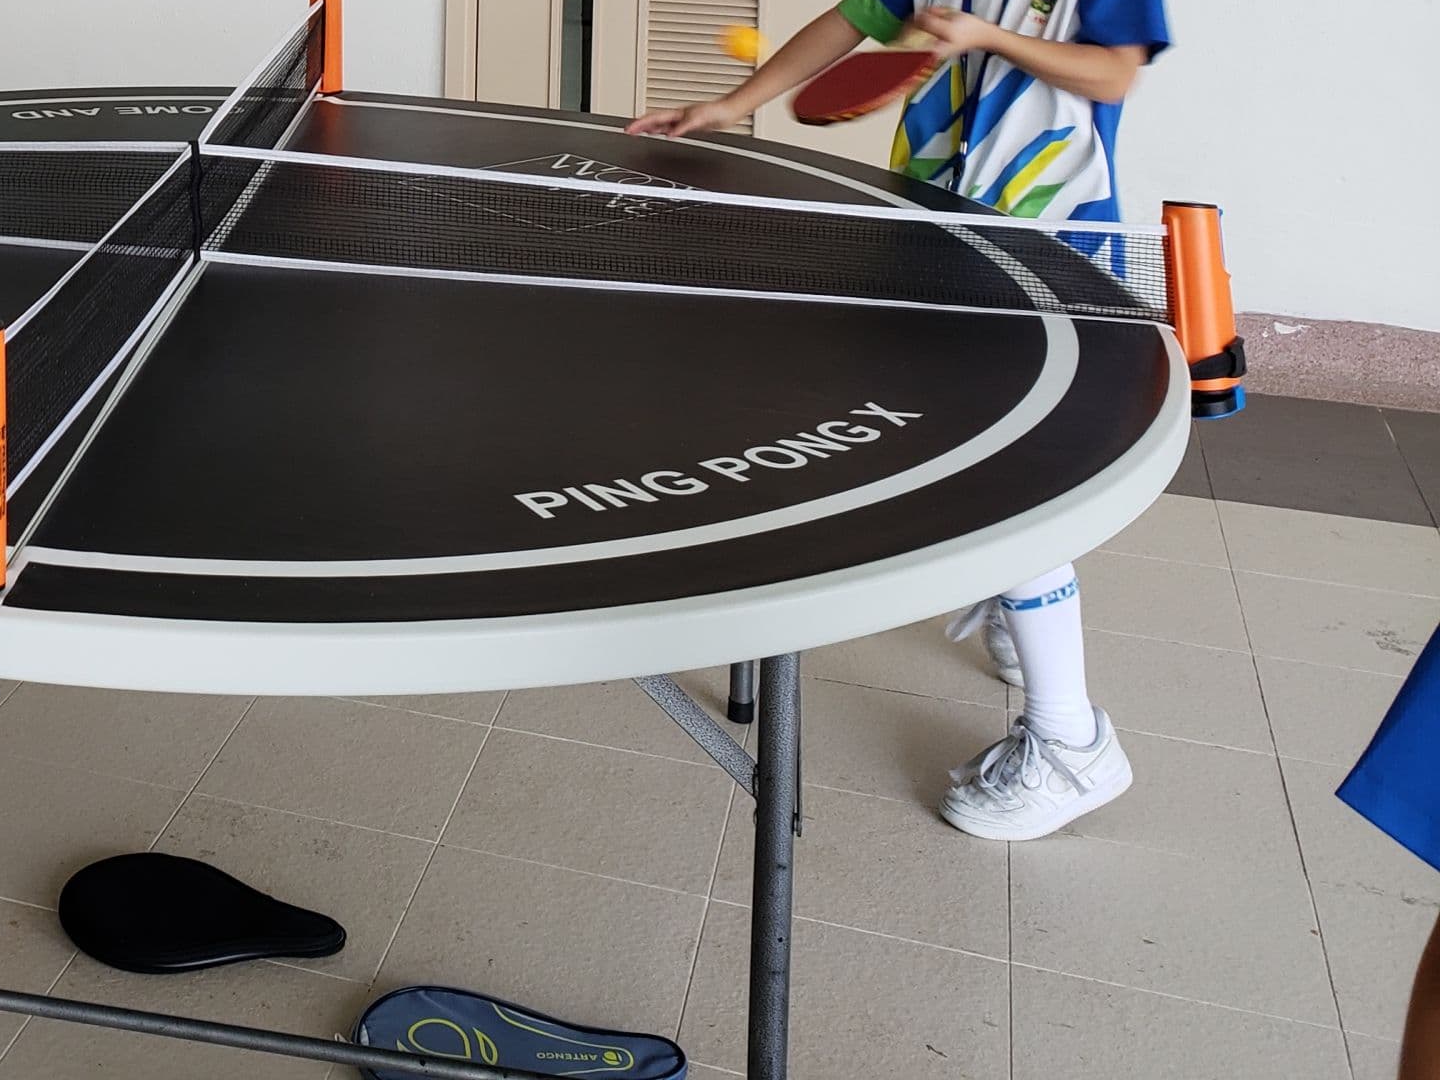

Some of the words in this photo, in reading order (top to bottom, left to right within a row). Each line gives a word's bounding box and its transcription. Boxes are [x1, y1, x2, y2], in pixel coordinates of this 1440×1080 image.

[11, 106, 102, 120] AND
[514, 469, 710, 519] PING
[698, 420, 881, 482] PONG
[849, 401, 925, 428] X
[536, 1052, 598, 1061] ARTENGO
